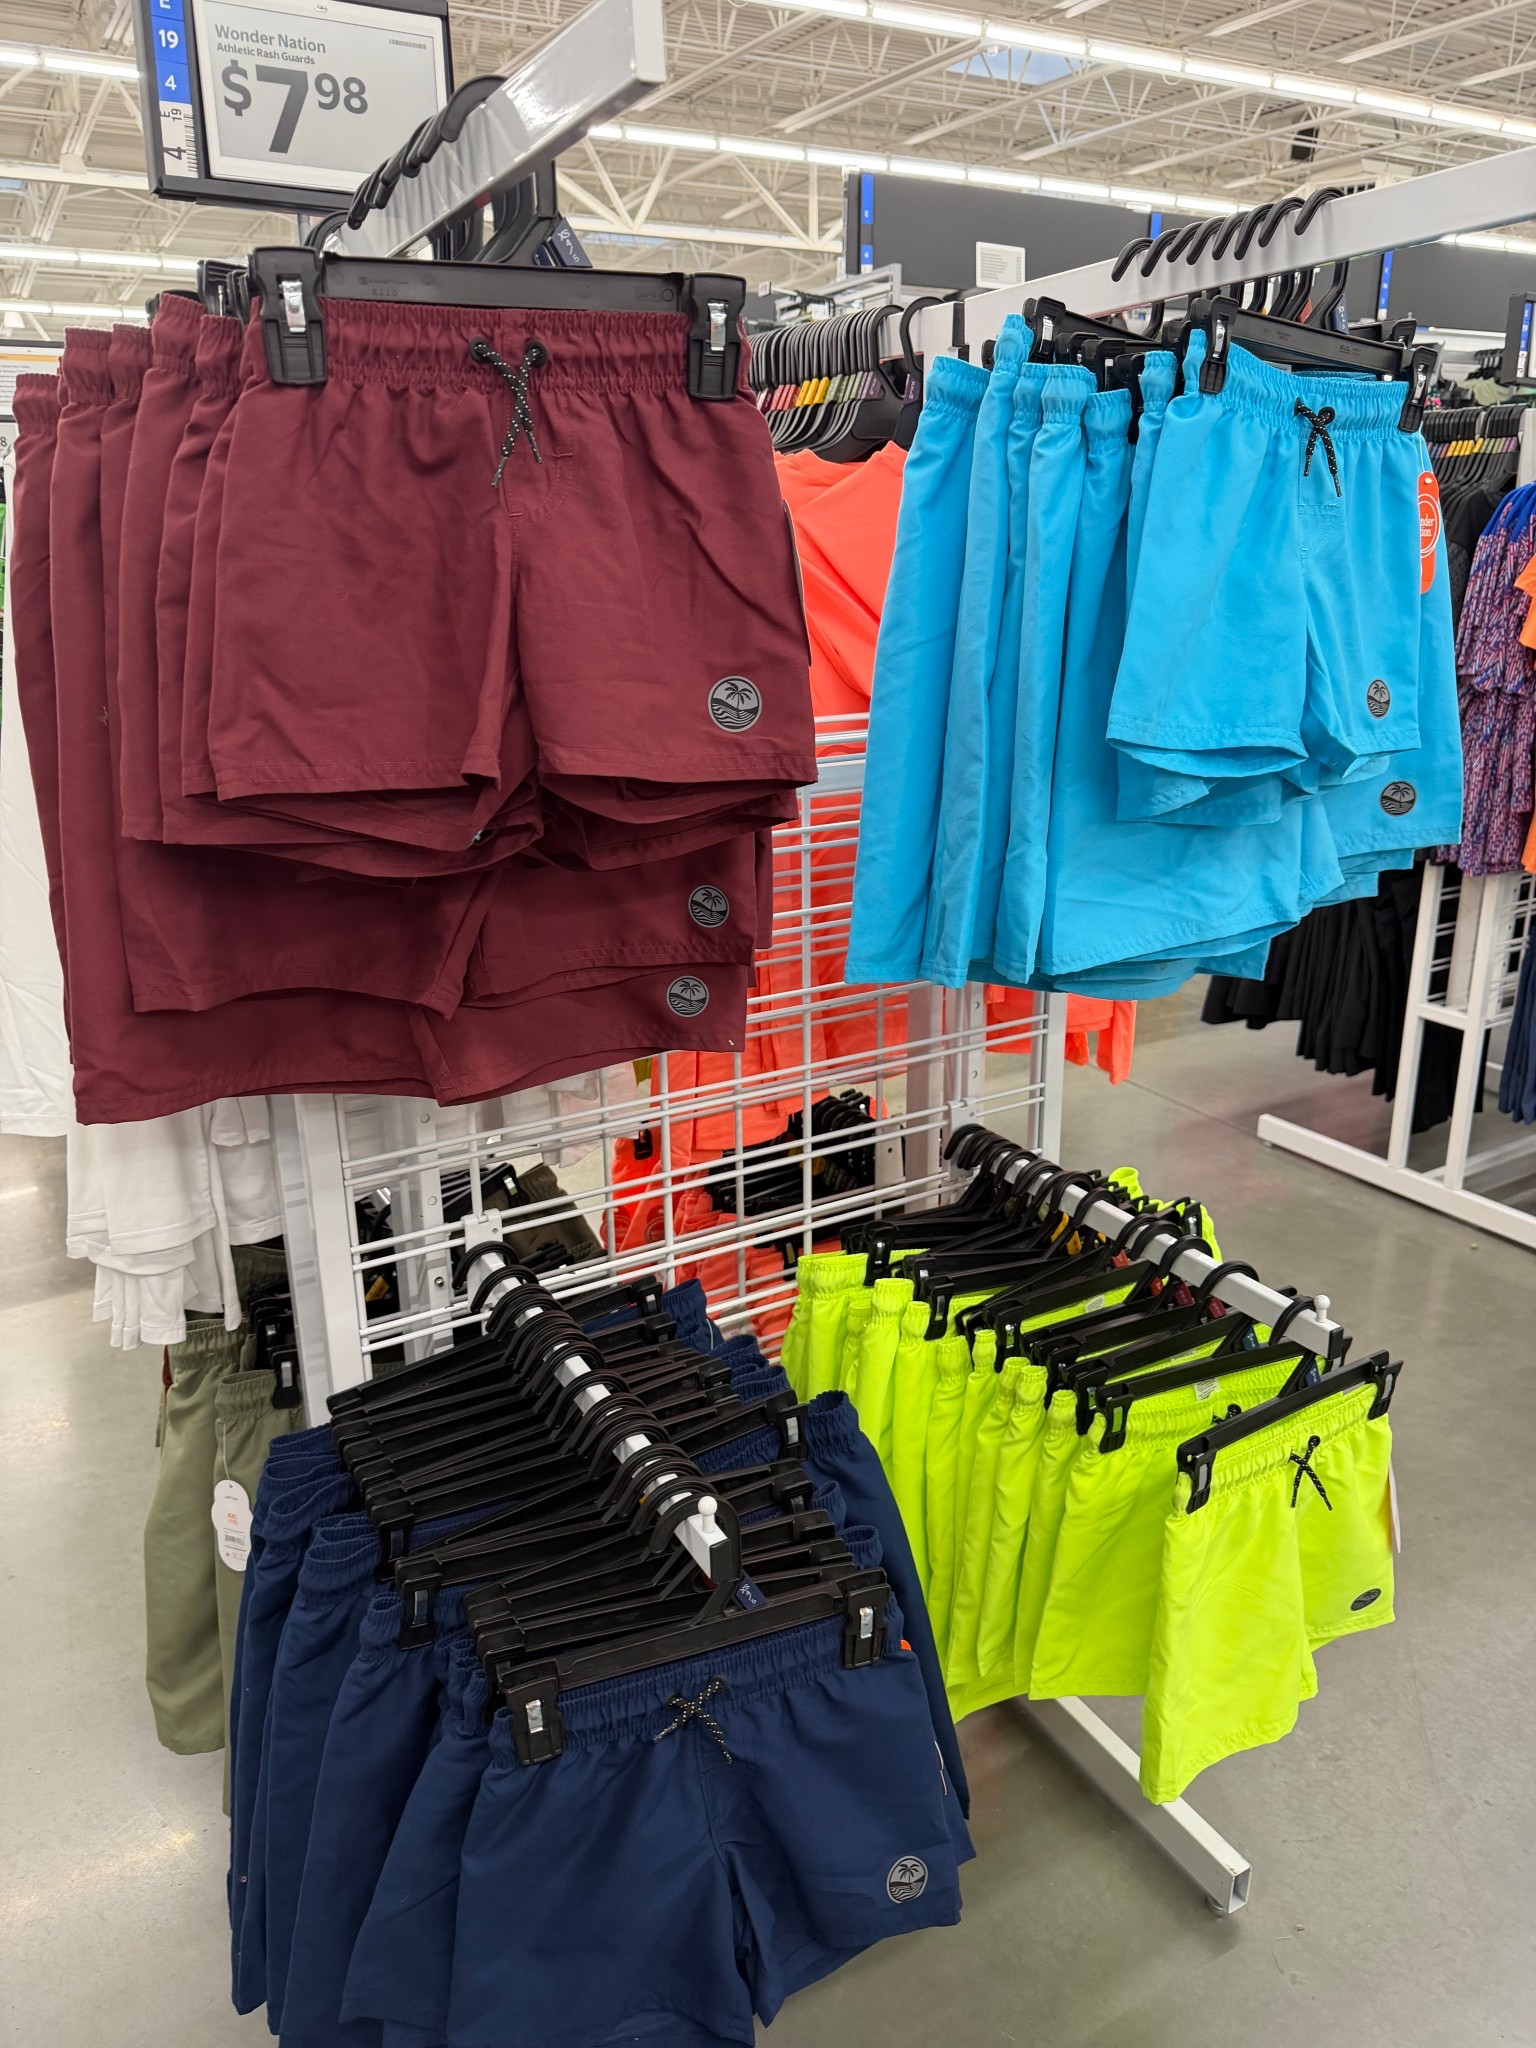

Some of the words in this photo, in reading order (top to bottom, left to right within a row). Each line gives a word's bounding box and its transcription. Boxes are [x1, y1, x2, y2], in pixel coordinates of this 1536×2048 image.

[158, 29, 179, 49] 19
[215, 24, 275, 48] Wonder
[277, 34, 327, 53] Nation
[216, 42, 256, 57] Athletic
[256, 47, 280, 61] Rash
[281, 51, 315, 65] Guards
[164, 75, 177, 91] 4
[160, 110, 171, 118] E
[171, 108, 182, 122] 19
[164, 146, 187, 161] 4
[1420, 513, 1435, 528] nder
